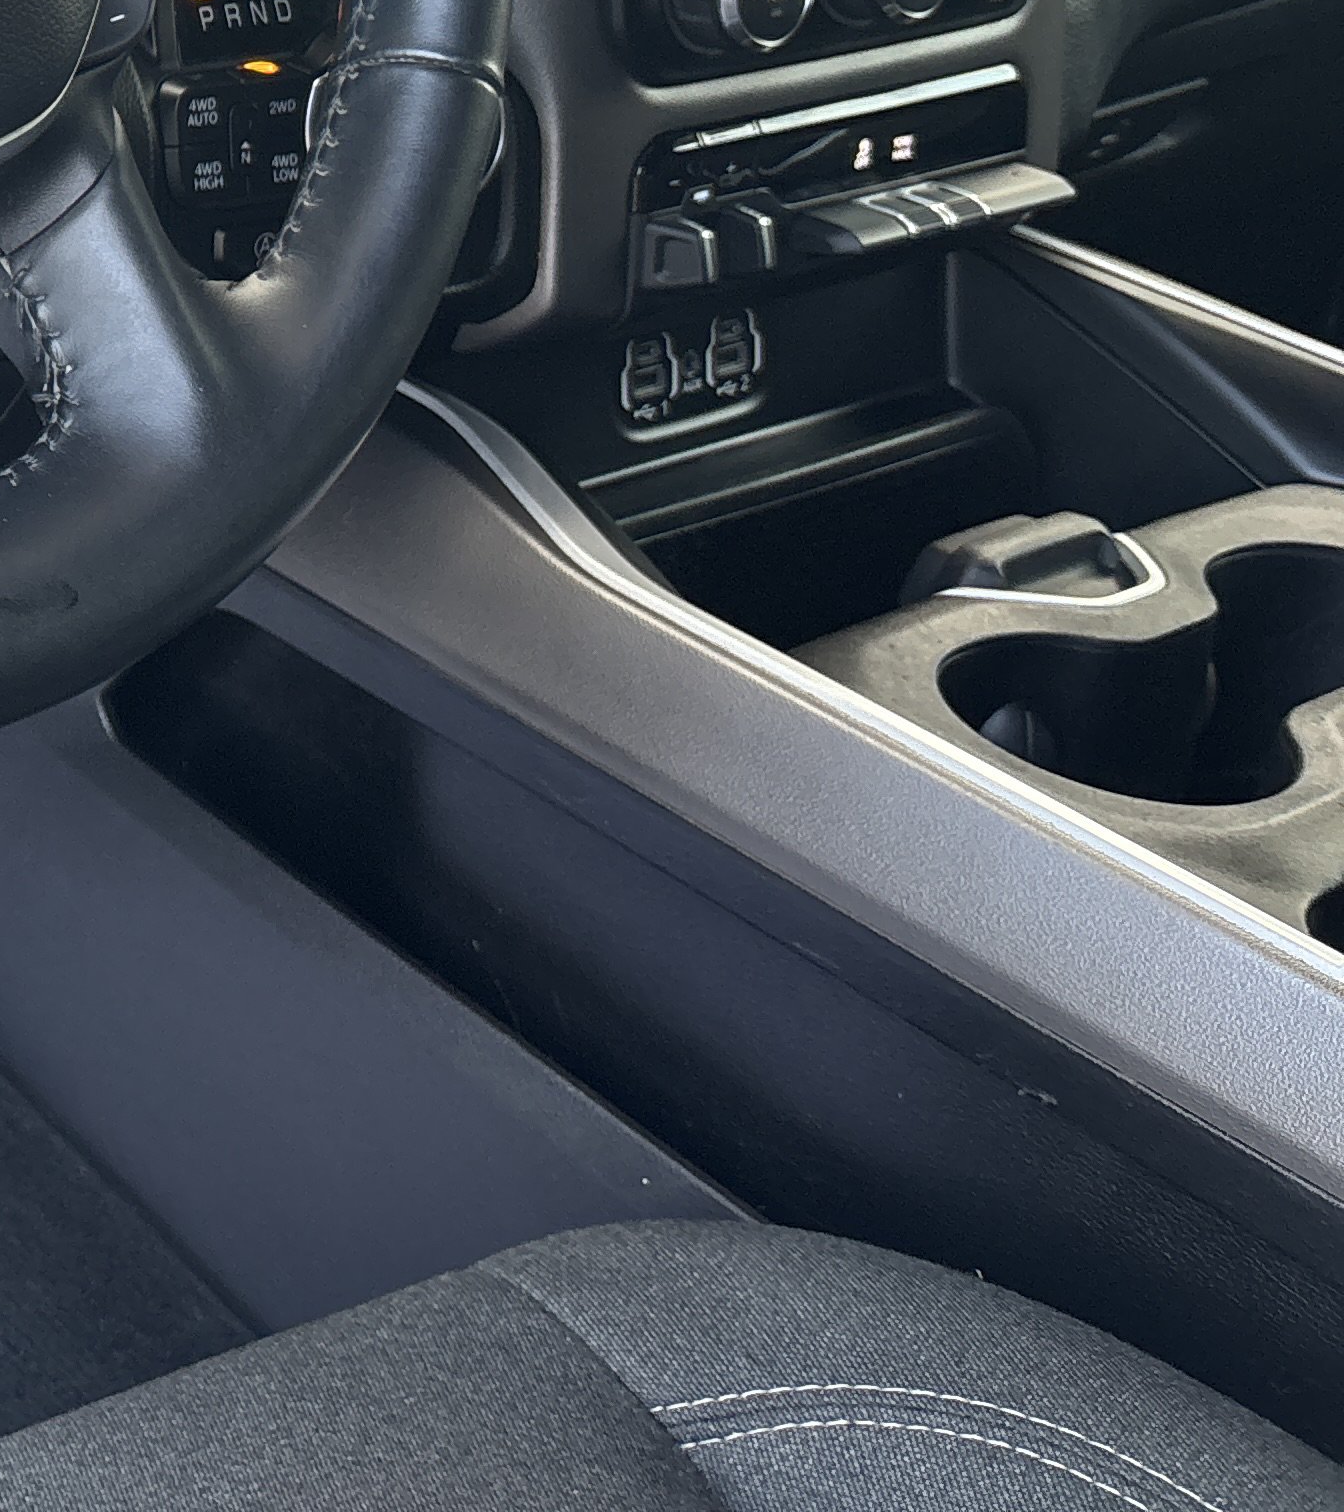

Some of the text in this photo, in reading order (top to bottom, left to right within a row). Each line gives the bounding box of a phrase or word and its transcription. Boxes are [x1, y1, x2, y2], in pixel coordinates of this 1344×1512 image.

[188, 96, 217, 113] 4WD
[268, 99, 297, 116] 2WD
[186, 111, 219, 128] AUTO
[194, 160, 223, 177] 4WD
[270, 152, 299, 168] 4WD
[193, 175, 225, 191] HIGH
[272, 167, 300, 184] LOW
